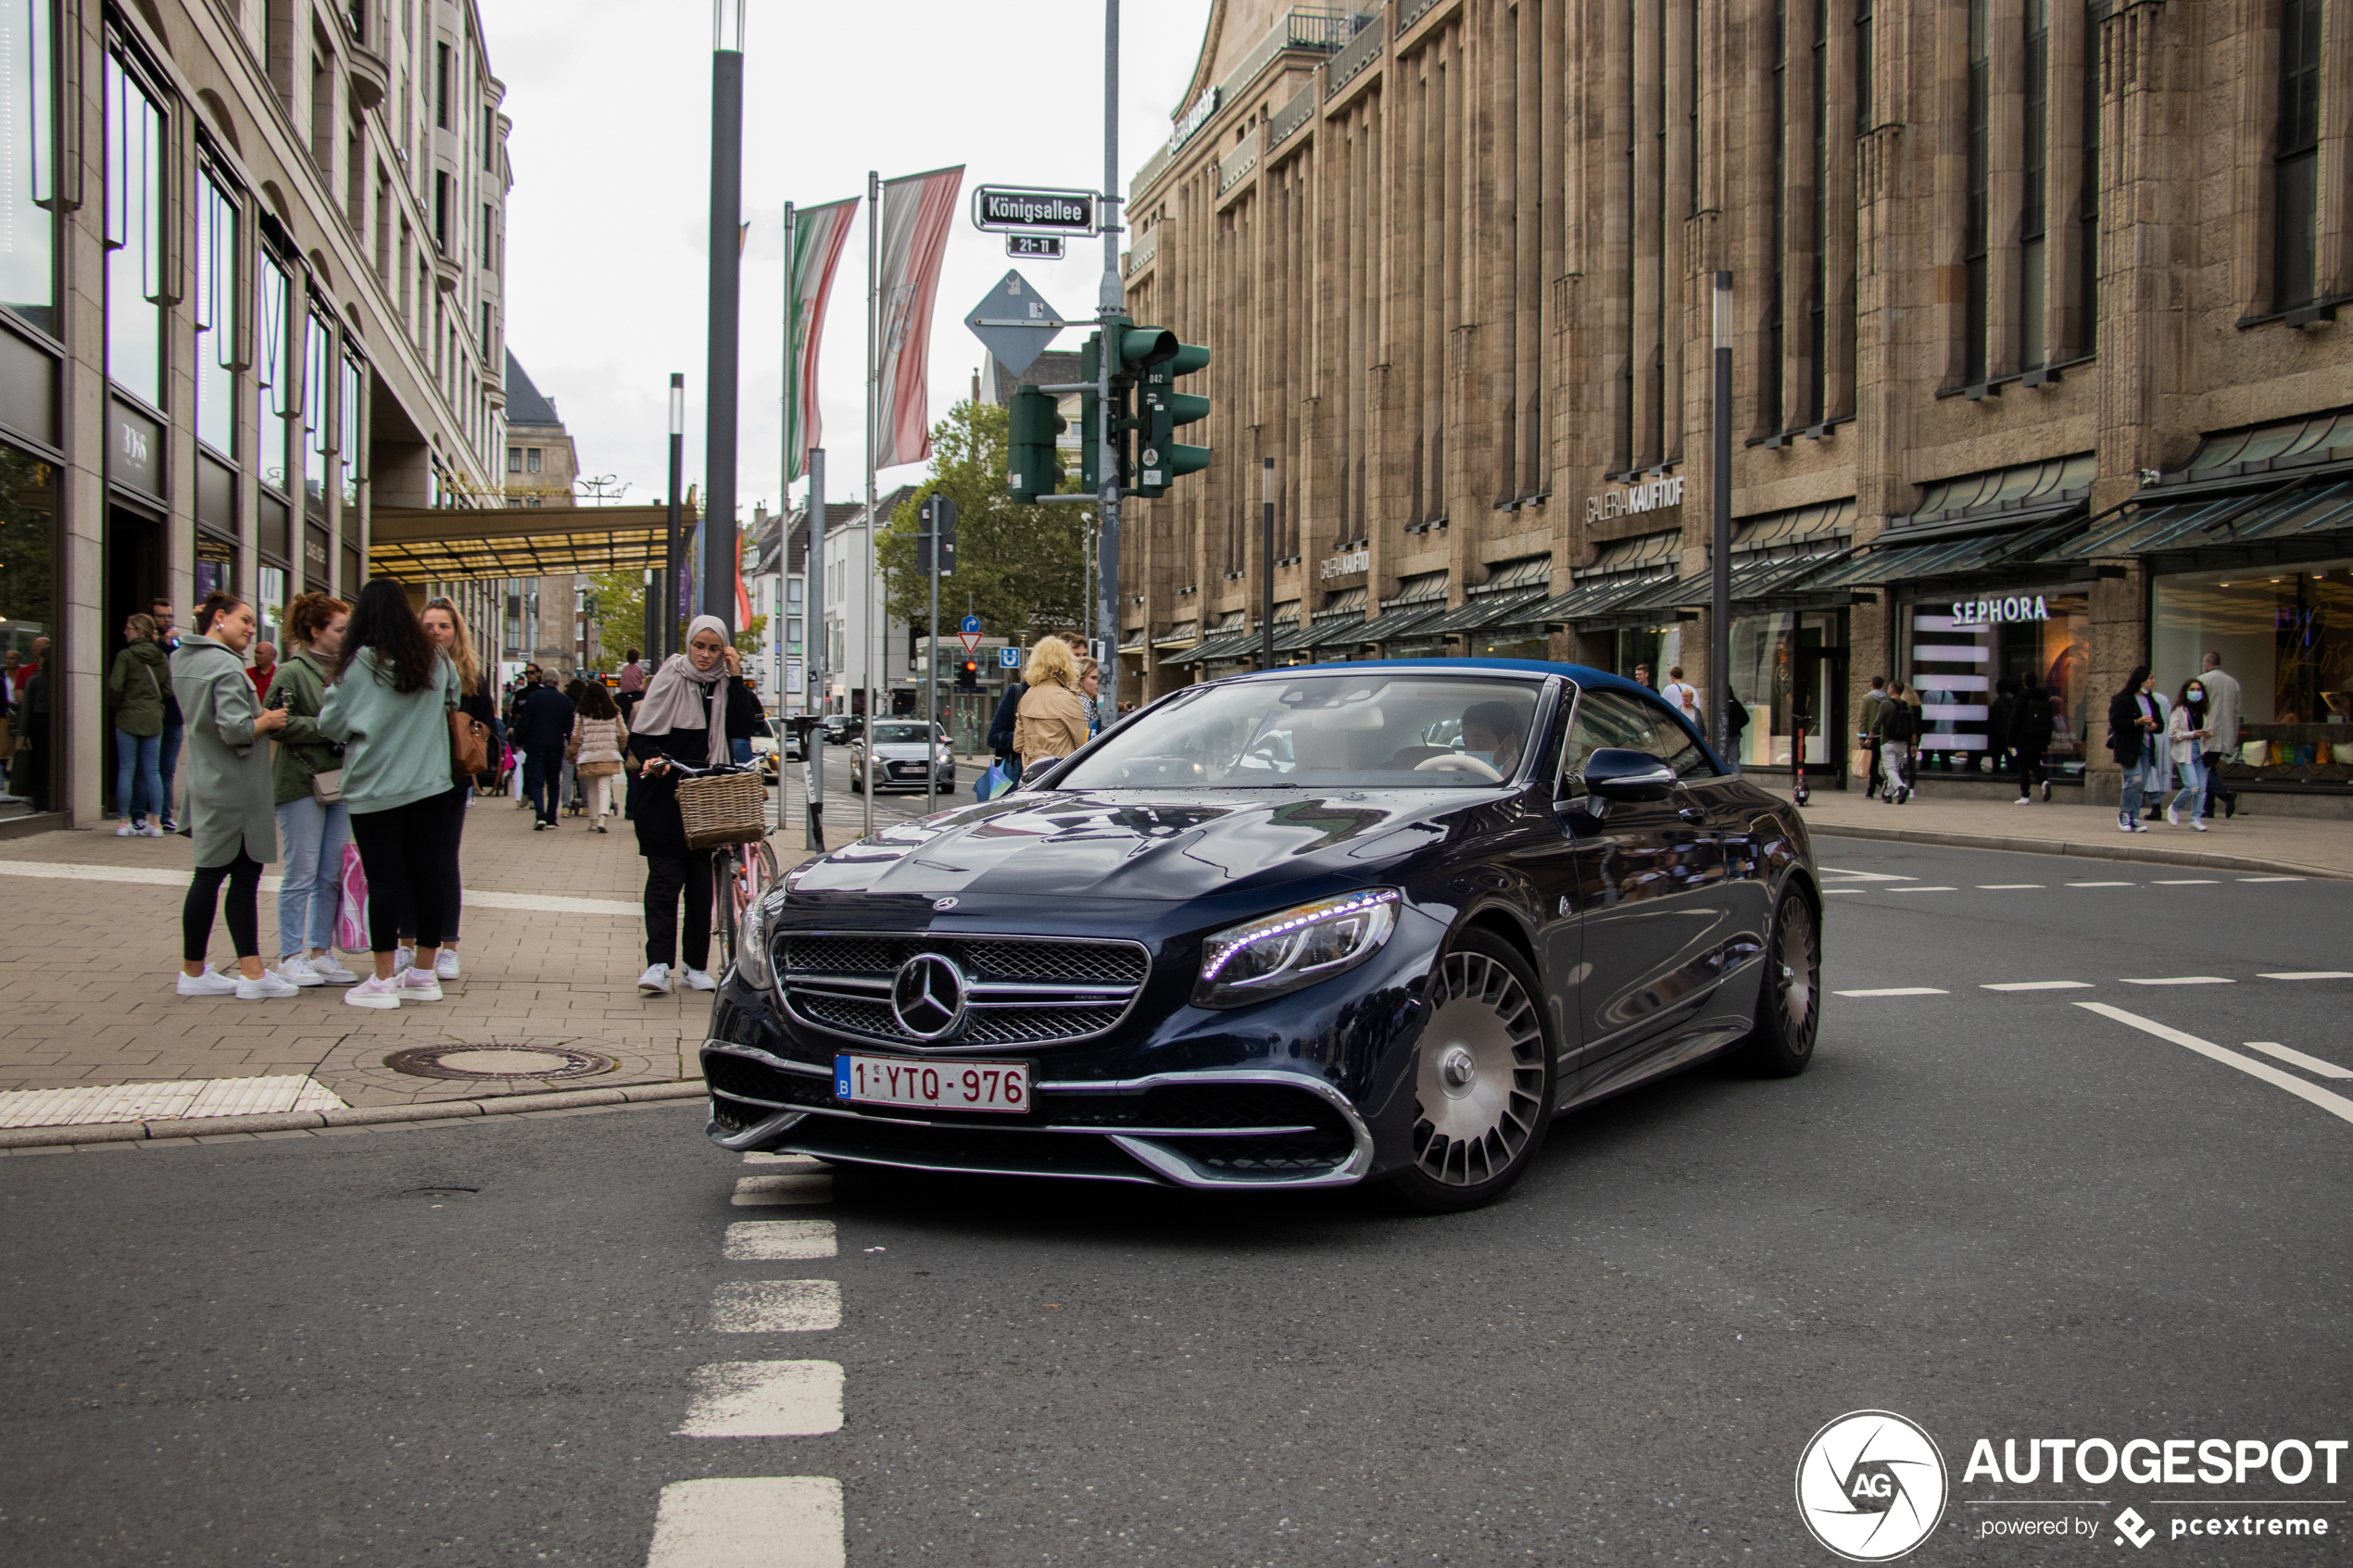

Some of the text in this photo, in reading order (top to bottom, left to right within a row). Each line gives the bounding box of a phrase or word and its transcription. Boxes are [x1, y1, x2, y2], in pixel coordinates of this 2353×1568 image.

[988, 195, 1082, 223] Königsallee
[1149, 373, 1164, 383] 042
[573, 473, 633, 505] Hof
[1585, 489, 1629, 524] GALERIA
[1320, 556, 1343, 580] GALERIA
[1952, 595, 2049, 625] SEPHORA
[839, 1062, 1024, 1104] B 1-YTQ-976
